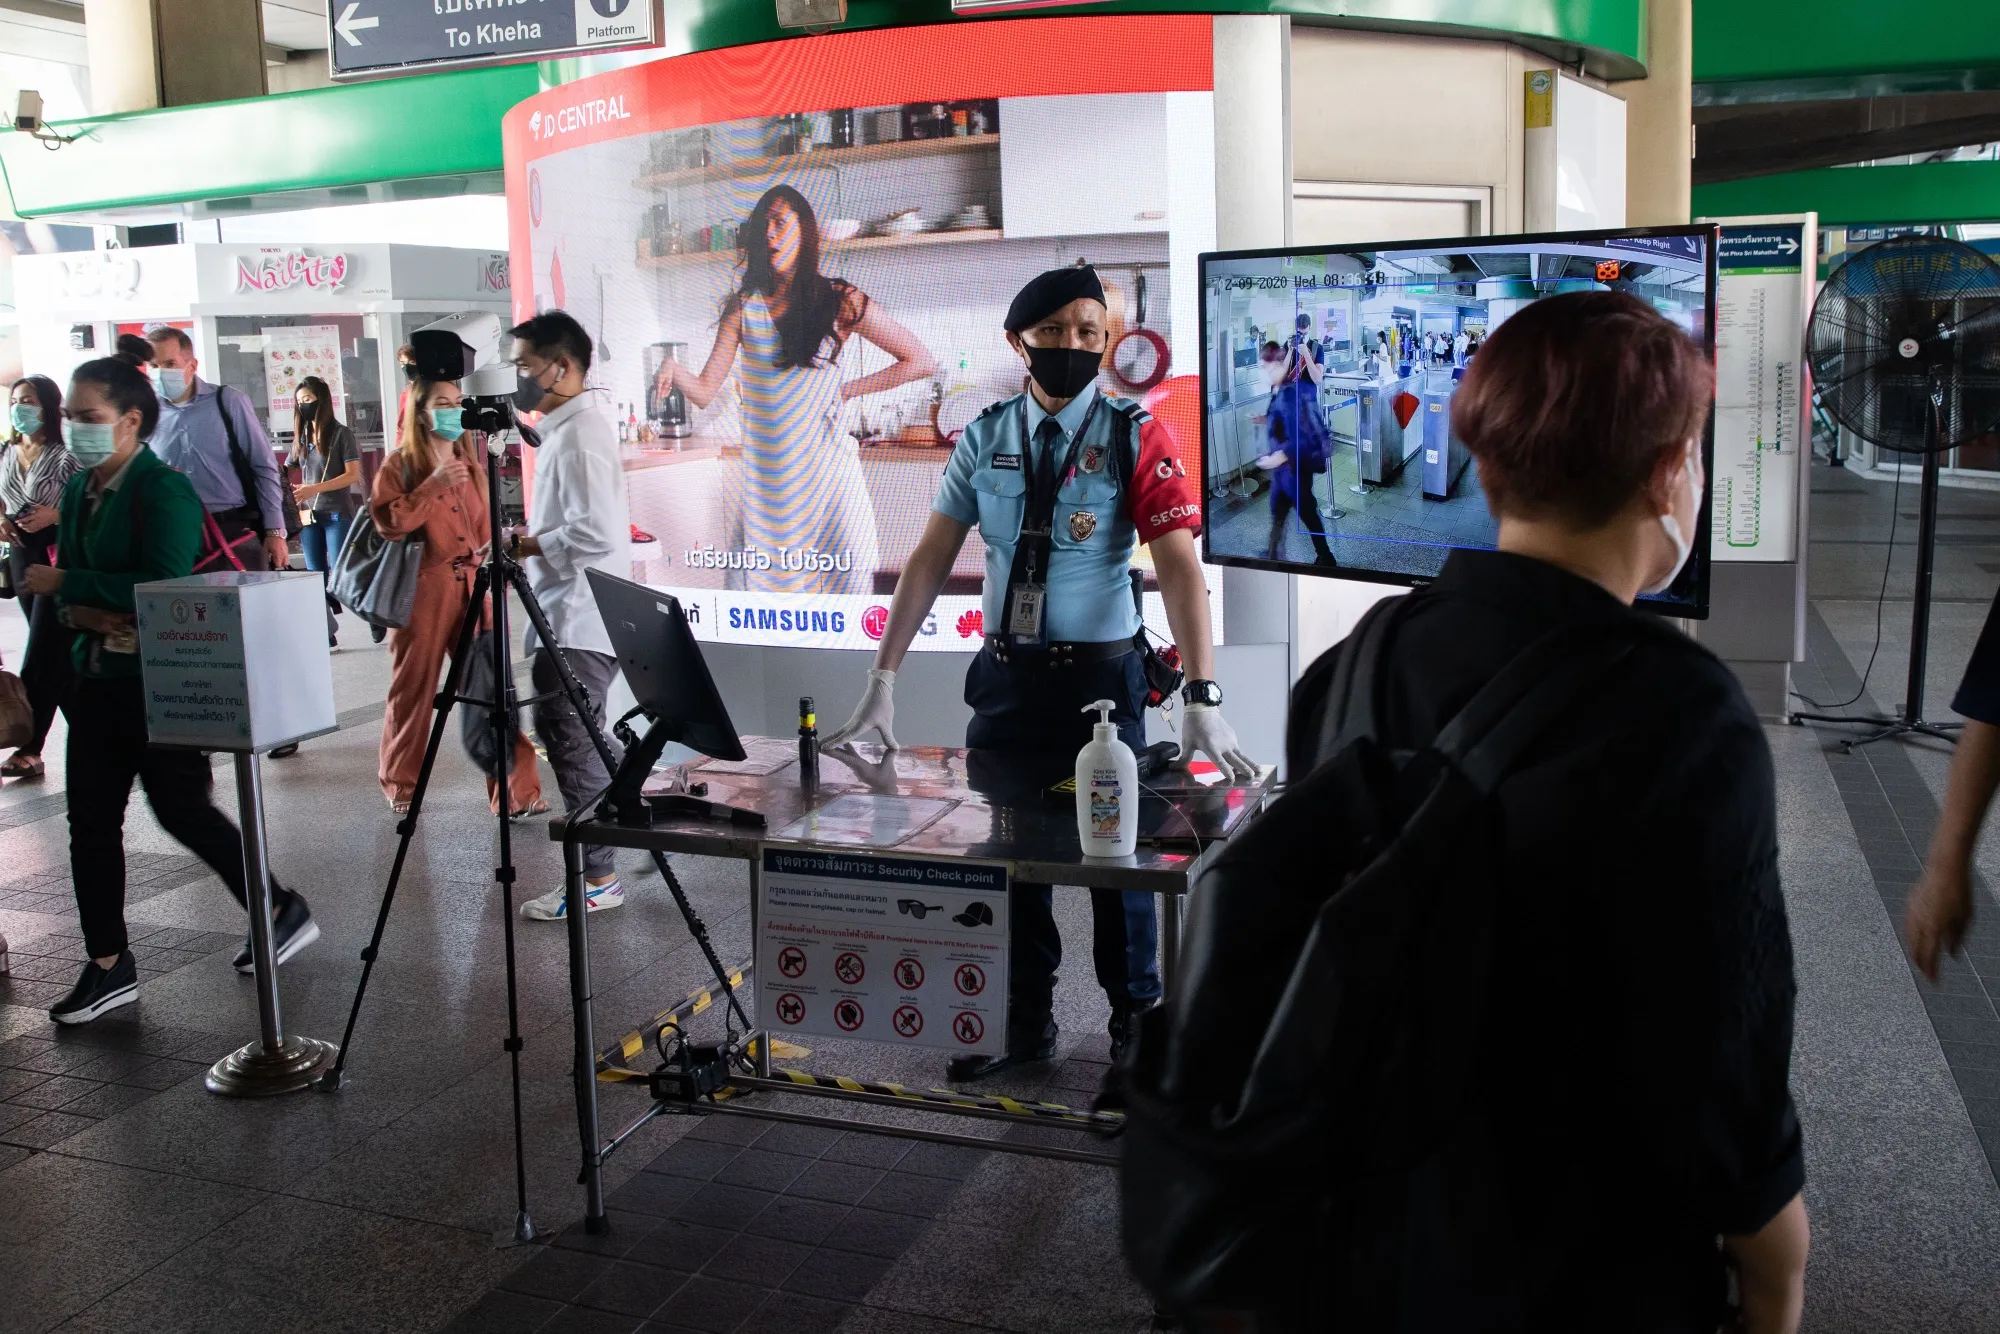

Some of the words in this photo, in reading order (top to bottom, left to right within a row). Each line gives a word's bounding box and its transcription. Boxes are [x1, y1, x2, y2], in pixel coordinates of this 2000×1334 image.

[445, 27, 471, 48] To
[476, 21, 542, 45] Kheha
[587, 24, 635, 38] Platform
[543, 114, 556, 139] JD
[558, 95, 631, 133] CENTRAL
[1652, 239, 1670, 249] Right
[239, 252, 299, 289] Nail
[485, 261, 512, 290] Nai
[1294, 274, 1316, 287] Wed
[729, 607, 845, 633] SAMSUNG
[775, 854, 875, 873] จุดตรวจสัมภาระ
[878, 864, 924, 880] Security
[926, 868, 962, 881] Check
[964, 872, 995, 884] point
[768, 899, 788, 907] Please
[788, 901, 810, 909] remove
[845, 906, 857, 915] cap
